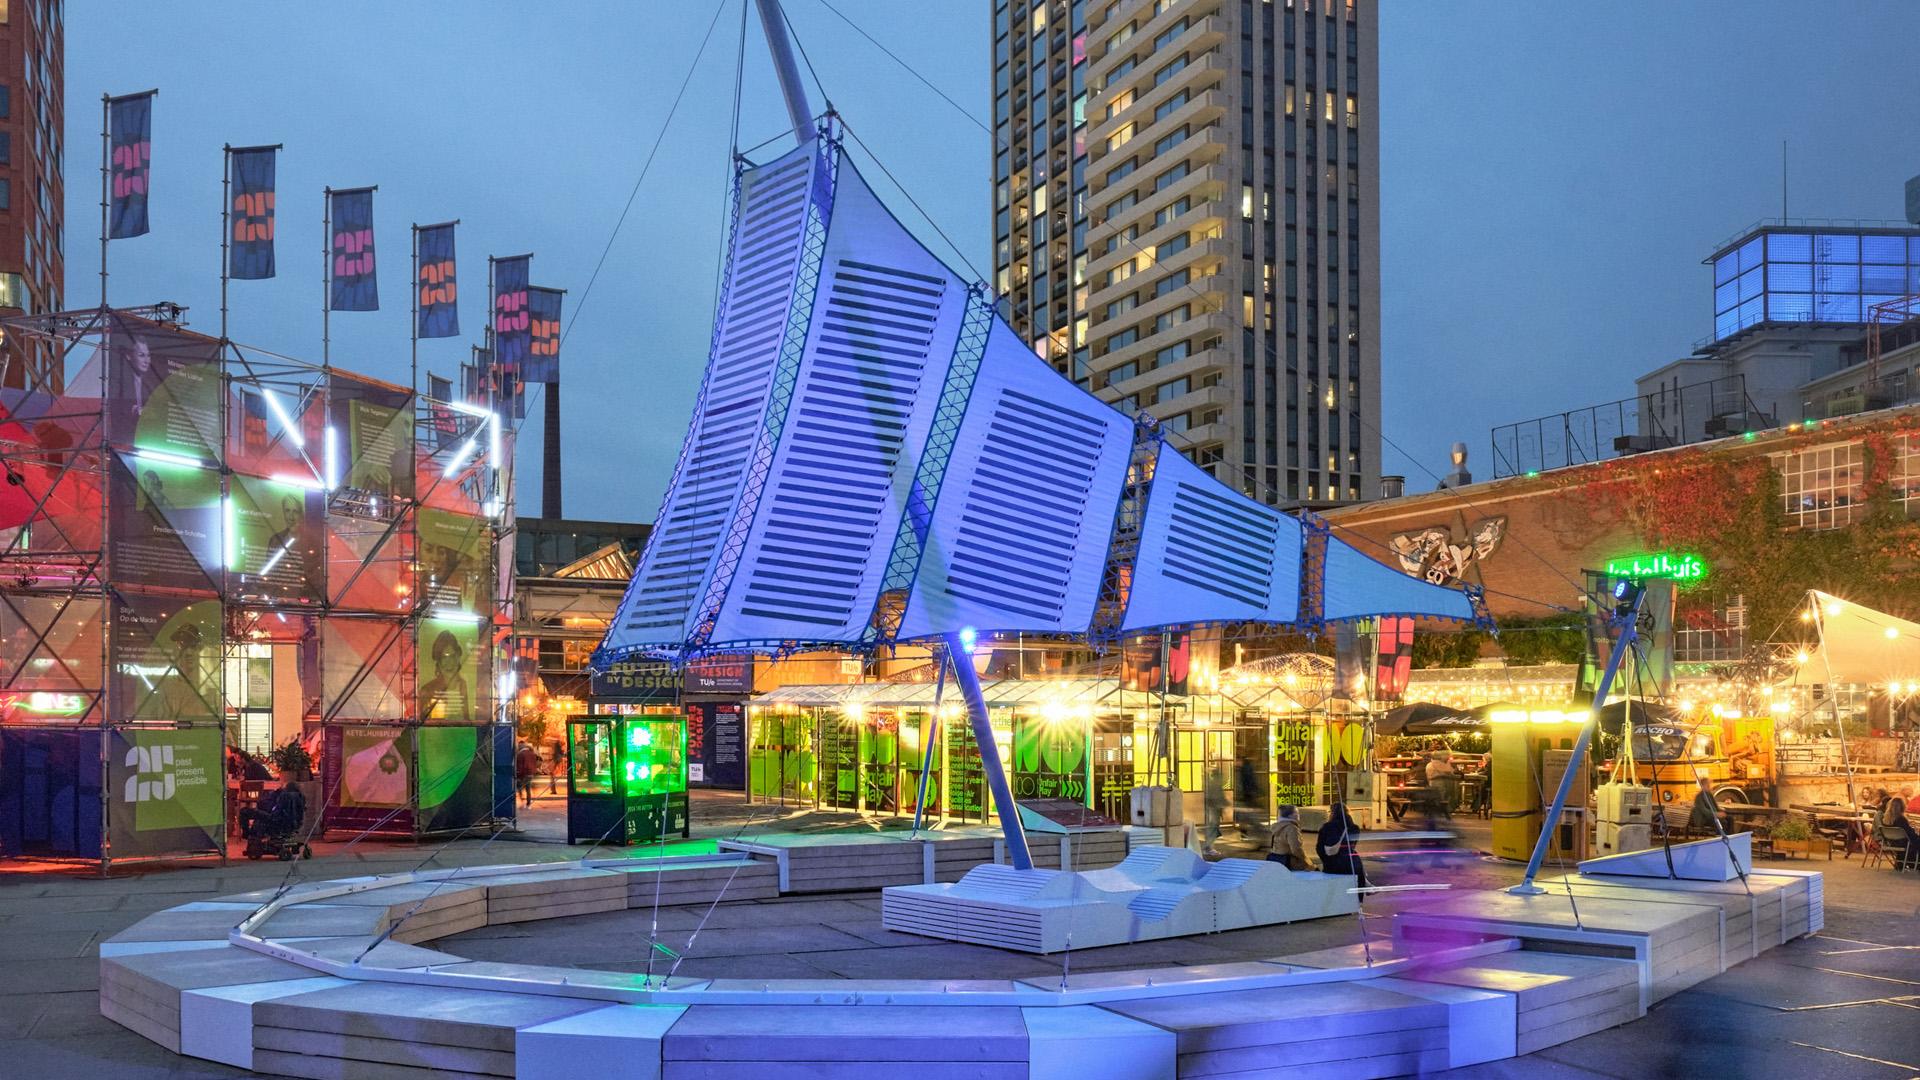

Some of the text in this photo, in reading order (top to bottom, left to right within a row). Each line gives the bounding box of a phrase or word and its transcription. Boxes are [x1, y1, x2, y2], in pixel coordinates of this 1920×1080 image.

[621, 677, 685, 688] DESIGN
[1274, 741, 1307, 765] Play
[175, 758, 192, 767] past
[175, 767, 204, 776] present
[176, 777, 208, 787] possible
